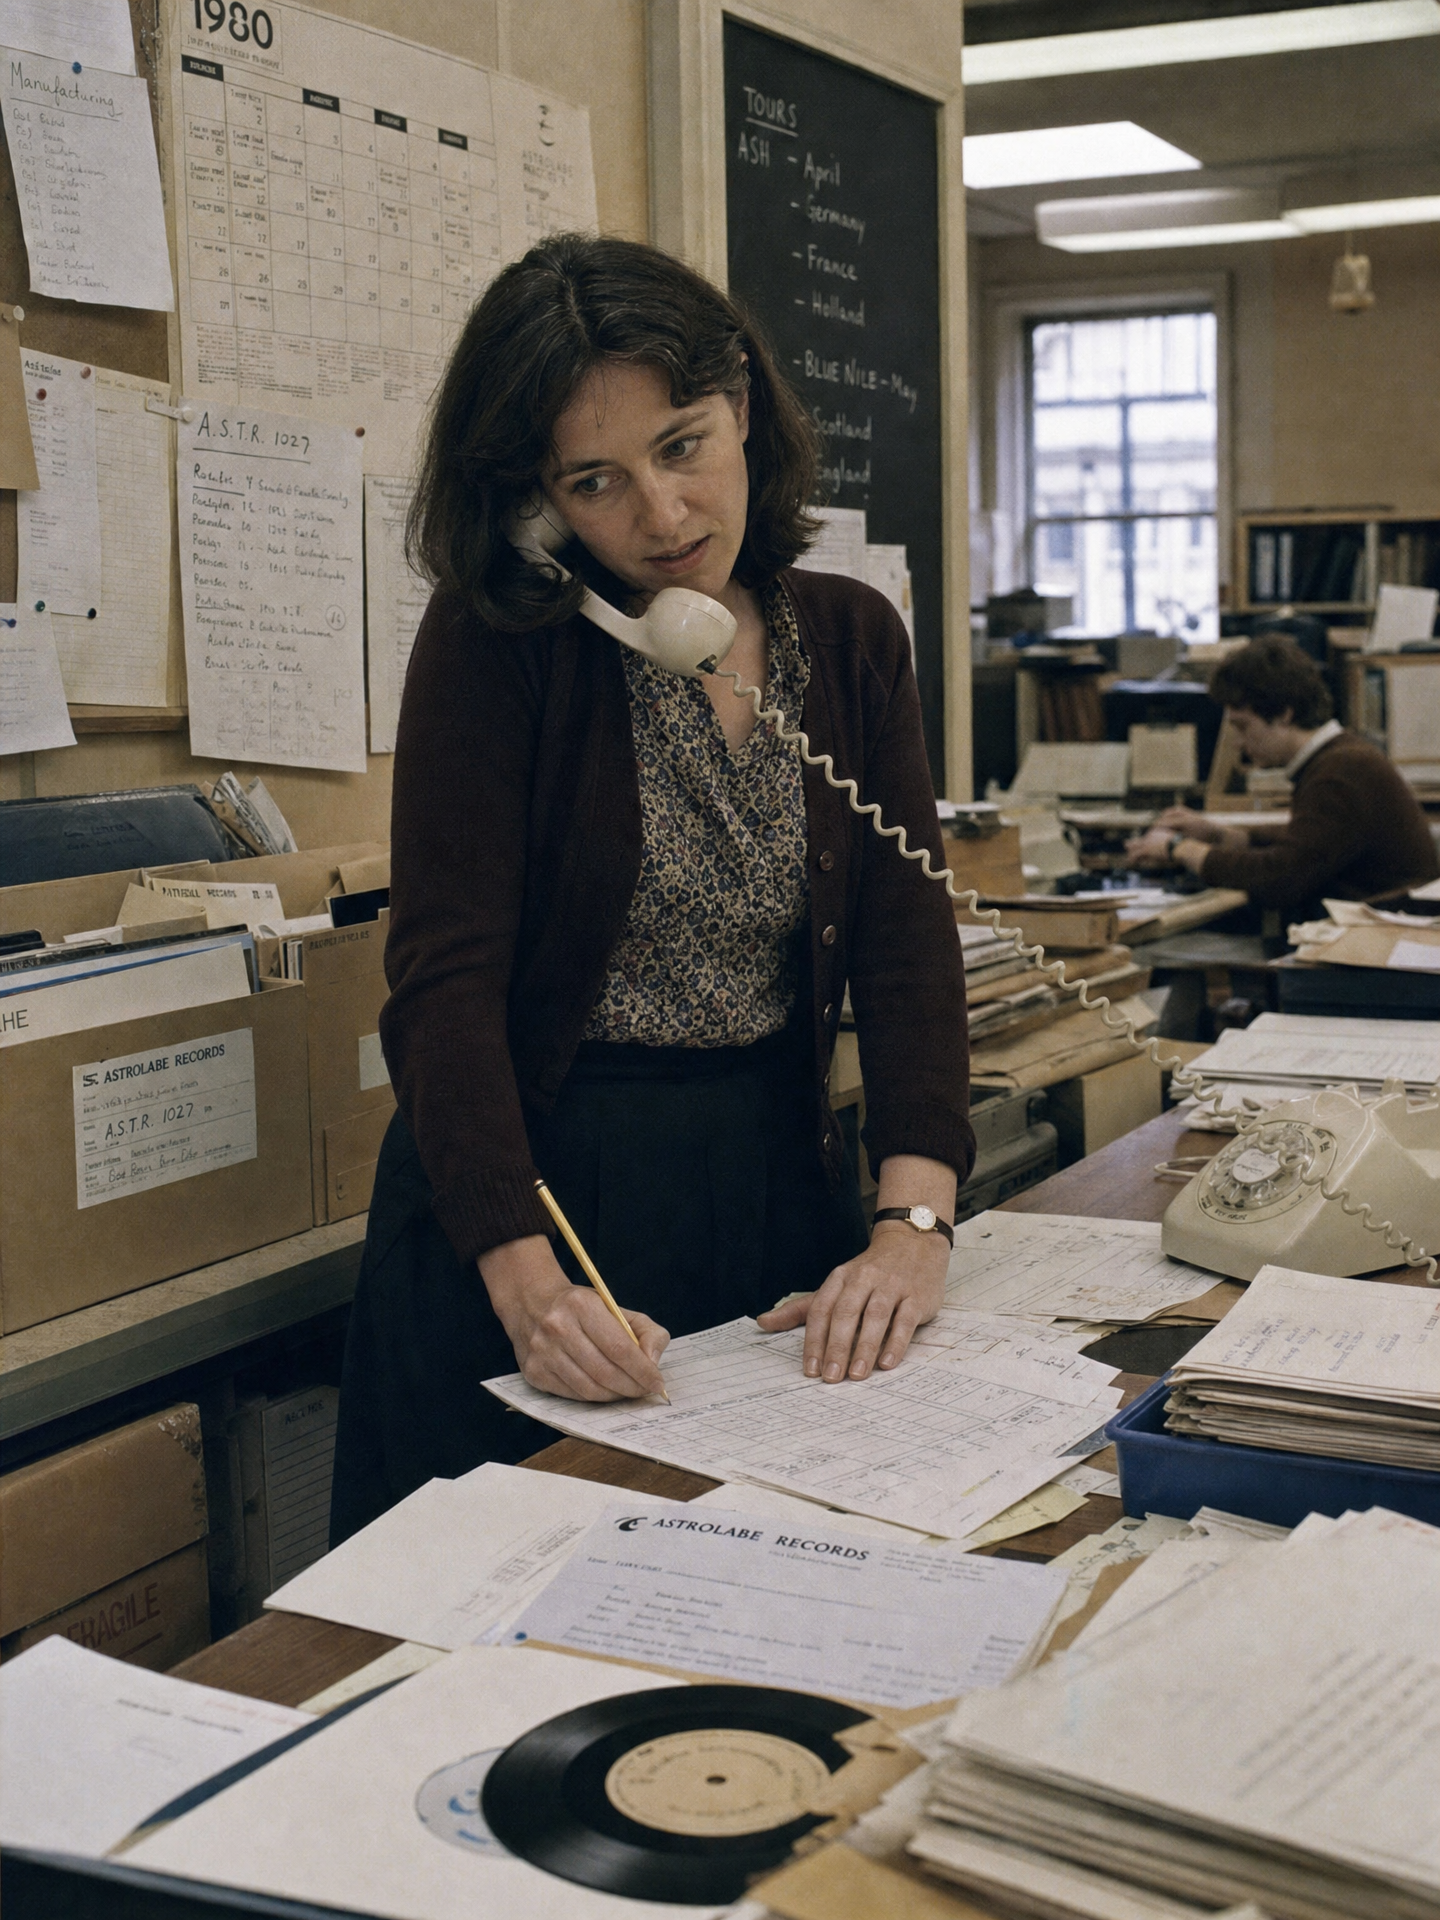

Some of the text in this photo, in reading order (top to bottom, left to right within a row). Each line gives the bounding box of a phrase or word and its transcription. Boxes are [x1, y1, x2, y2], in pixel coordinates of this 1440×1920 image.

[194, 0, 274, 50] 1980
[11, 61, 122, 117] Manufacturing
[743, 86, 798, 128] TOURS
[738, 131, 770, 168] ASH
[803, 152, 840, 191] April
[805, 194, 866, 245] Germany
[807, 243, 858, 281] France
[812, 289, 866, 327] Holland
[805, 349, 840, 383] BLUE
[843, 358, 878, 390] NILE
[891, 372, 918, 414] May
[197, 411, 310, 455] A.S.T.R. 1027
[0, 1009, 29, 1033] HE
[103, 1043, 226, 1084] ASTROLABE RECORDS
[105, 1102, 194, 1141] A.S.T.R. 1027
[651, 1517, 871, 1562] ASTROLABE RECORDS
[66, 1581, 161, 1649] FRAGILE
